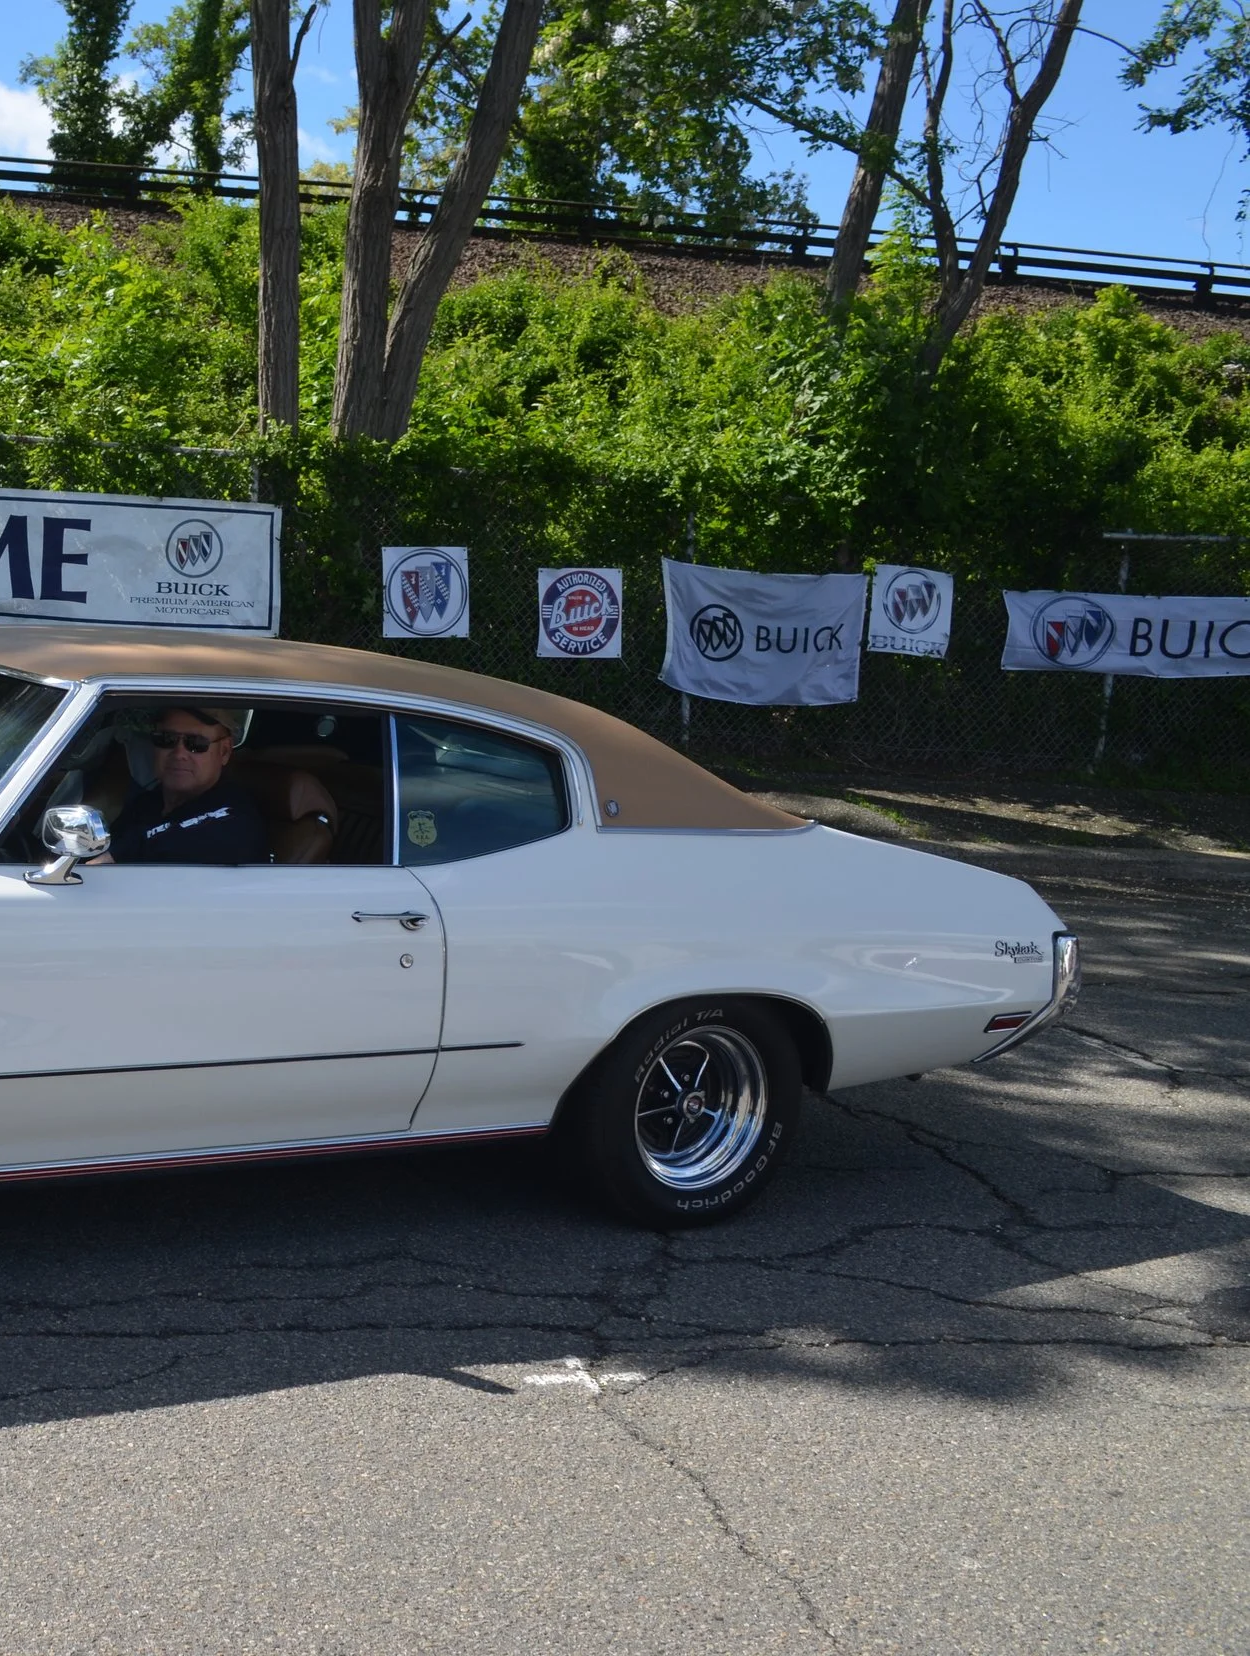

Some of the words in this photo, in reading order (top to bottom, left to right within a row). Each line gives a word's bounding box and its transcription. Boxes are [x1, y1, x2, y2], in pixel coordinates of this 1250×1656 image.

[155, 581, 230, 596] BUICK
[556, 573, 607, 593] AUTHORIZED
[130, 596, 188, 606] PREMIUM
[192, 599, 255, 608] AMERICAN
[155, 606, 230, 616] MOTORCARS
[549, 592, 614, 629] Buick
[551, 632, 607, 653] SERVICE
[754, 623, 844, 653] BUICK
[870, 635, 947, 657] BUICK
[1130, 617, 1250, 659] BUIC
[634, 1017, 688, 1082] Radial
[696, 1008, 723, 1021] T/A
